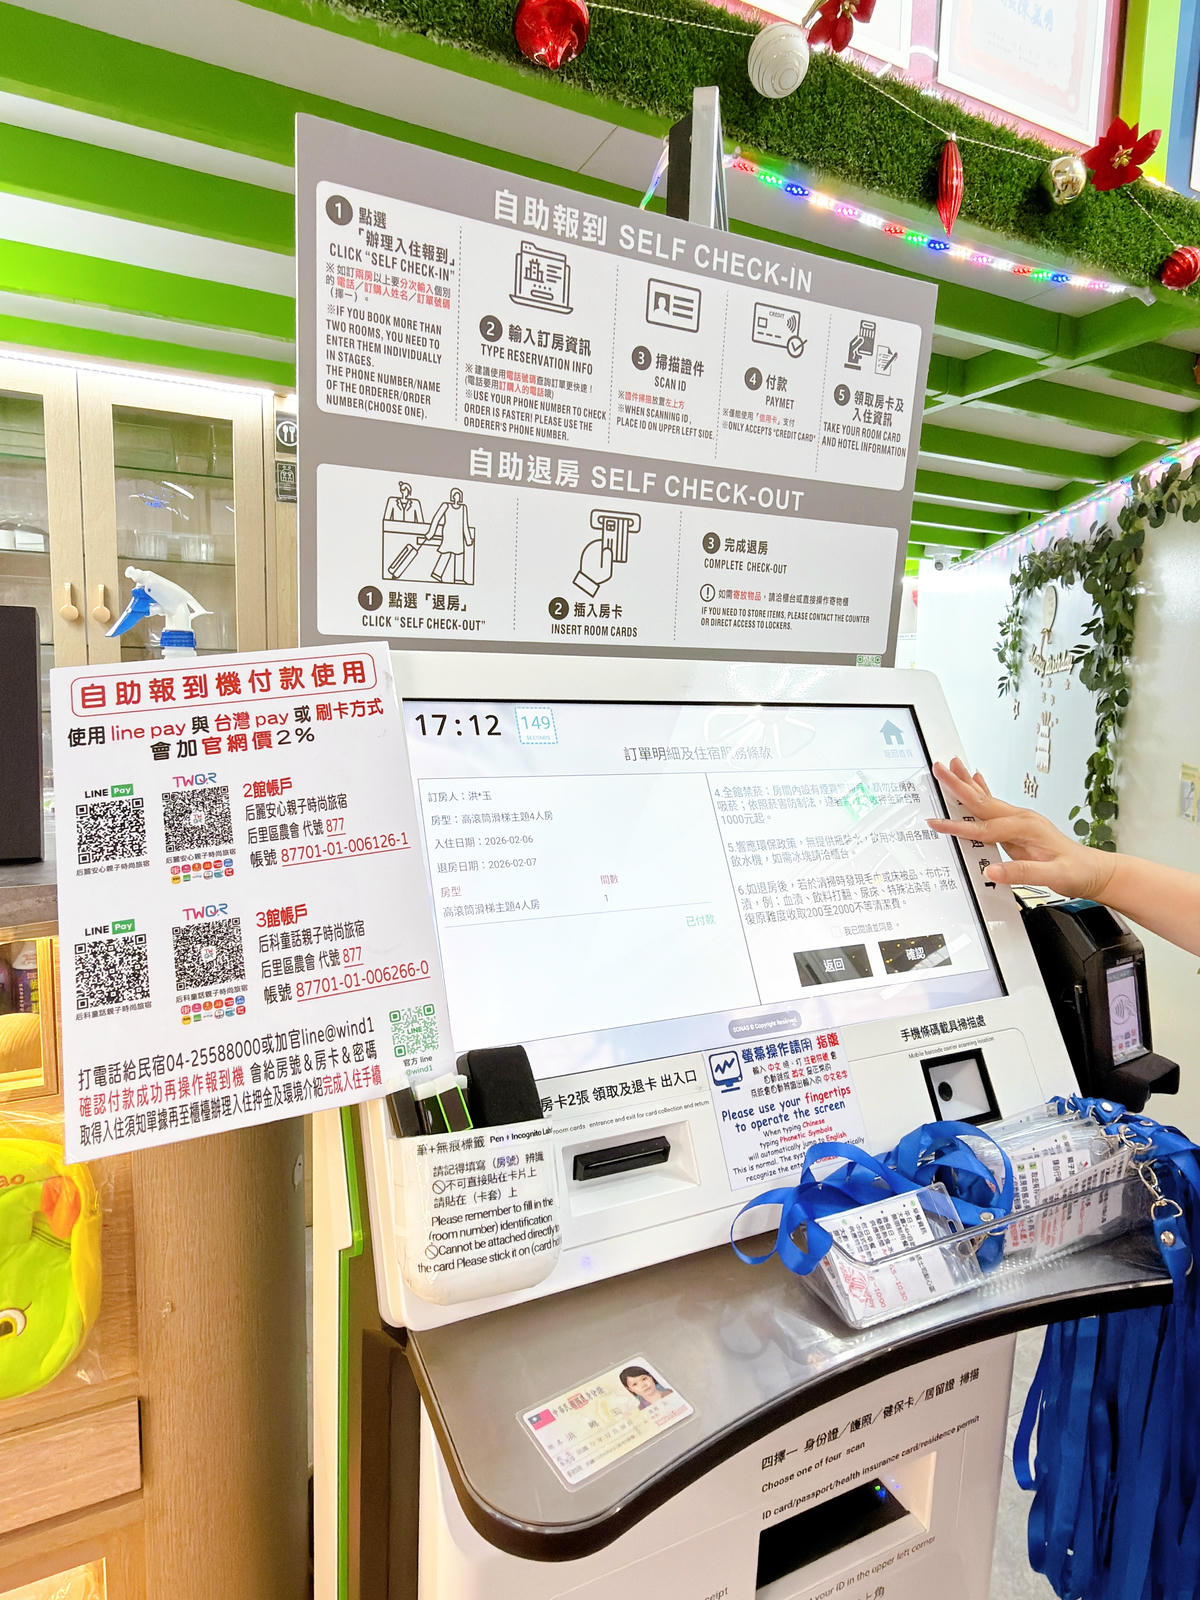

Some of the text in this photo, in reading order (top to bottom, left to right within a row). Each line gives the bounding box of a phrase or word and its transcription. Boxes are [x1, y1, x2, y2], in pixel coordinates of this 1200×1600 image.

[359, 207, 387, 229] 點選
[494, 188, 813, 294] 自助報到 SELF CHECK-IN
[326, 334, 442, 364] ENTER THEM INDIVIDUALLY
[508, 324, 592, 357] 輸入訂房資訊
[326, 349, 375, 367] IN STAGES.
[481, 343, 593, 375] TYPE RESERVATION INFO
[655, 353, 704, 378] 掃描證件
[326, 364, 441, 393] THE PHONE NUMBER/NAME
[654, 376, 687, 392] SCAN ID
[766, 374, 788, 392] 付款
[326, 379, 431, 405] OF THE ORDERER/ORDER
[765, 395, 794, 410] PAYMET
[854, 390, 904, 413] 領取房卡及
[852, 407, 893, 427] 入住資訊
[823, 421, 901, 443] TAKE YOUR ROOM CARD
[822, 435, 906, 458] AND HOTEL INFORMATION
[468, 447, 805, 511] 自助退房 SELF CHECK-OUT
[724, 537, 768, 556] 完成退房
[704, 558, 787, 574] COMPLETE CHECK-OUT
[573, 602, 623, 619] 插入房卡
[551, 623, 638, 638] INSERT ROOM CARDS
[80, 659, 367, 710] 自助報到機付款使用
[67, 697, 384, 748] 使用 line pay 與 台灣 pay 或 刷卡方式
[415, 714, 551, 736] 17:12 149
[85, 786, 132, 799] LINE Pay
[242, 777, 293, 799] 2館帳戶
[245, 793, 348, 822] 后麗安心親子時尚旅宿
[247, 817, 345, 845] 后里區農會 代號 877
[434, 835, 534, 850] 入住日期：2026-02-06
[250, 831, 409, 869] 帳號 87701-01-006126-1
[437, 857, 537, 873] 退房日期：2026-02-07
[440, 886, 462, 898] 房型
[600, 874, 619, 885] 間數
[255, 903, 308, 928] 3館帳戶
[686, 914, 716, 928] 已付款
[85, 922, 133, 937] LINE Pay
[258, 919, 365, 953] 后科童話親子時尚旅宿
[261, 946, 362, 979] 后里區農會 代號 877
[823, 956, 846, 973] 返回
[905, 945, 926, 961] 確認
[263, 960, 429, 1005] 帳號 87701-01-006266-0
[900, 1014, 987, 1042] 手機條碼載具掃描處
[403, 1054, 432, 1067] 官方 line
[742, 1032, 840, 1064] 螢幕操作請用 指腹
[78, 1065, 245, 1119] 確認付款成功再操作報到機
[592, 1077, 658, 1101] 領取及退卡
[661, 1069, 697, 1088] 出入口
[722, 1085, 852, 1122] Please use your fingertips
[735, 1100, 846, 1133] to operate the screen
[763, 1118, 825, 1138] When typing Chinese
[446, 1166, 537, 1190] 不可直接貼在卡片上
[429, 1214, 553, 1242] (room number) identification
[438, 1225, 556, 1256] Cannot be attached directly
[417, 1263, 432, 1273] the
[433, 1258, 455, 1272] card
[456, 1255, 488, 1268] Please
[488, 1248, 511, 1262] stick
[511, 1248, 518, 1258] it
[518, 1246, 530, 1255] on
[761, 1448, 798, 1470] 四擇一
[959, 1368, 980, 1387] 掃描
[761, 1440, 866, 1493] Choose one of four scan
[762, 1415, 980, 1520] ID card/passport/health insurance card/residence permit
[835, 1580, 845, 1591] ID
[847, 1575, 855, 1585] in
[856, 1569, 870, 1581] the
[871, 1557, 895, 1574] upper
[896, 1548, 910, 1561] left
[911, 1536, 936, 1553] corner
